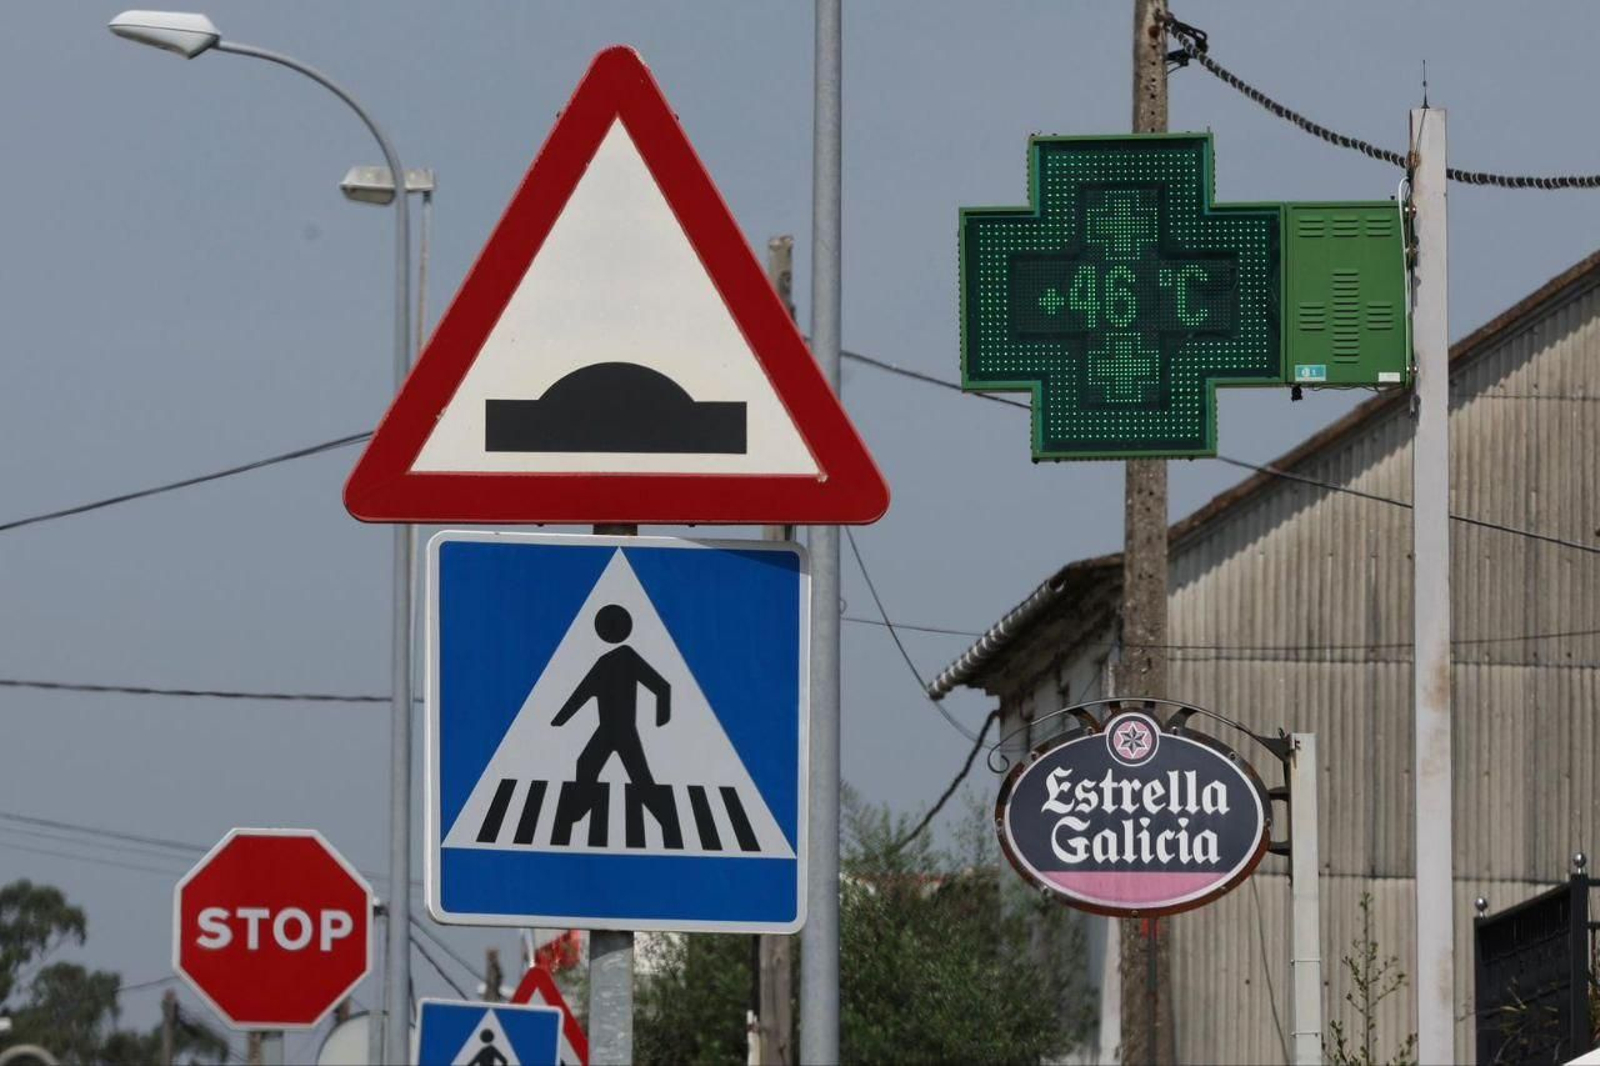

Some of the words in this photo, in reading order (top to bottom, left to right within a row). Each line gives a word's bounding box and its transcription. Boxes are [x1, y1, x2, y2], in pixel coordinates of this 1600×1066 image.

[1039, 265, 1136, 328] +46
[1159, 264, 1208, 326] °C
[1041, 766, 1230, 814] Estrella
[1051, 816, 1221, 864] Galicia
[196, 907, 353, 951] STOP
